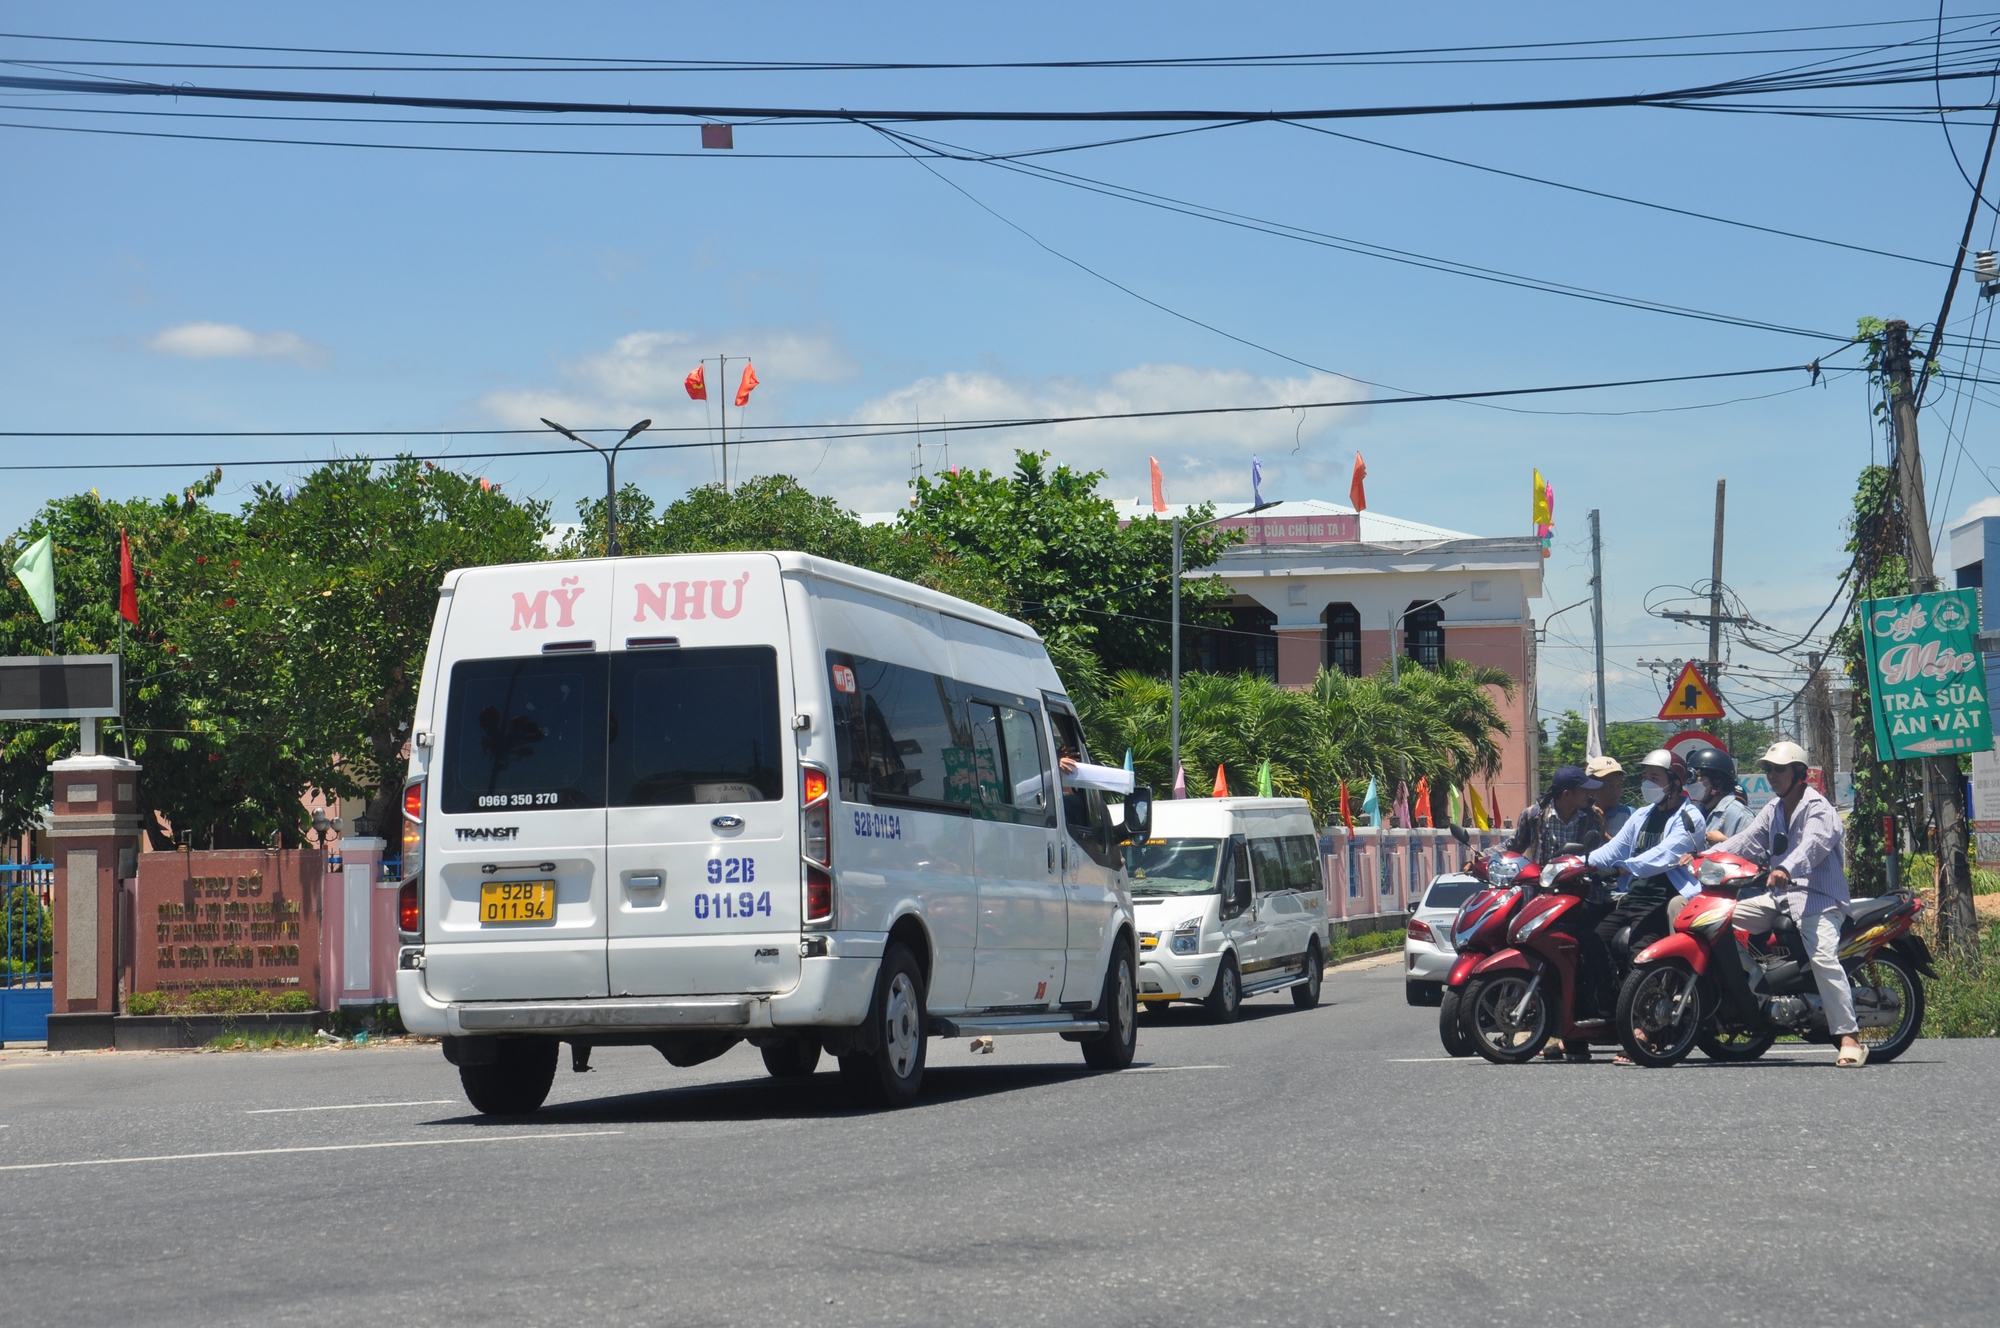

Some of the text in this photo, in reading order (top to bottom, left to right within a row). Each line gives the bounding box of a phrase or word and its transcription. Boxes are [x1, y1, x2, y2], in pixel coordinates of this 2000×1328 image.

[1264, 520, 1285, 538] CỦA
[1288, 521, 1324, 537] CHÚNG
[1326, 523, 1339, 536] TA
[510, 571, 750, 631] MỸ NHƯ
[1879, 640, 1976, 685] Mộc
[1882, 684, 1985, 711] TRÀ SỮA
[1892, 708, 1981, 736] ĂN VẶT
[1920, 741, 1947, 750] 200M
[478, 793, 558, 807] 0969 350 370
[455, 827, 519, 839] TRANSIT
[707, 858, 755, 884] 92B
[191, 869, 263, 895] TRỤ SỞ
[502, 883, 533, 900] 92B
[488, 901, 545, 919] 011.94
[695, 891, 772, 919] 011.94
[257, 944, 299, 959] TRUNG
[754, 948, 779, 957] ABS
